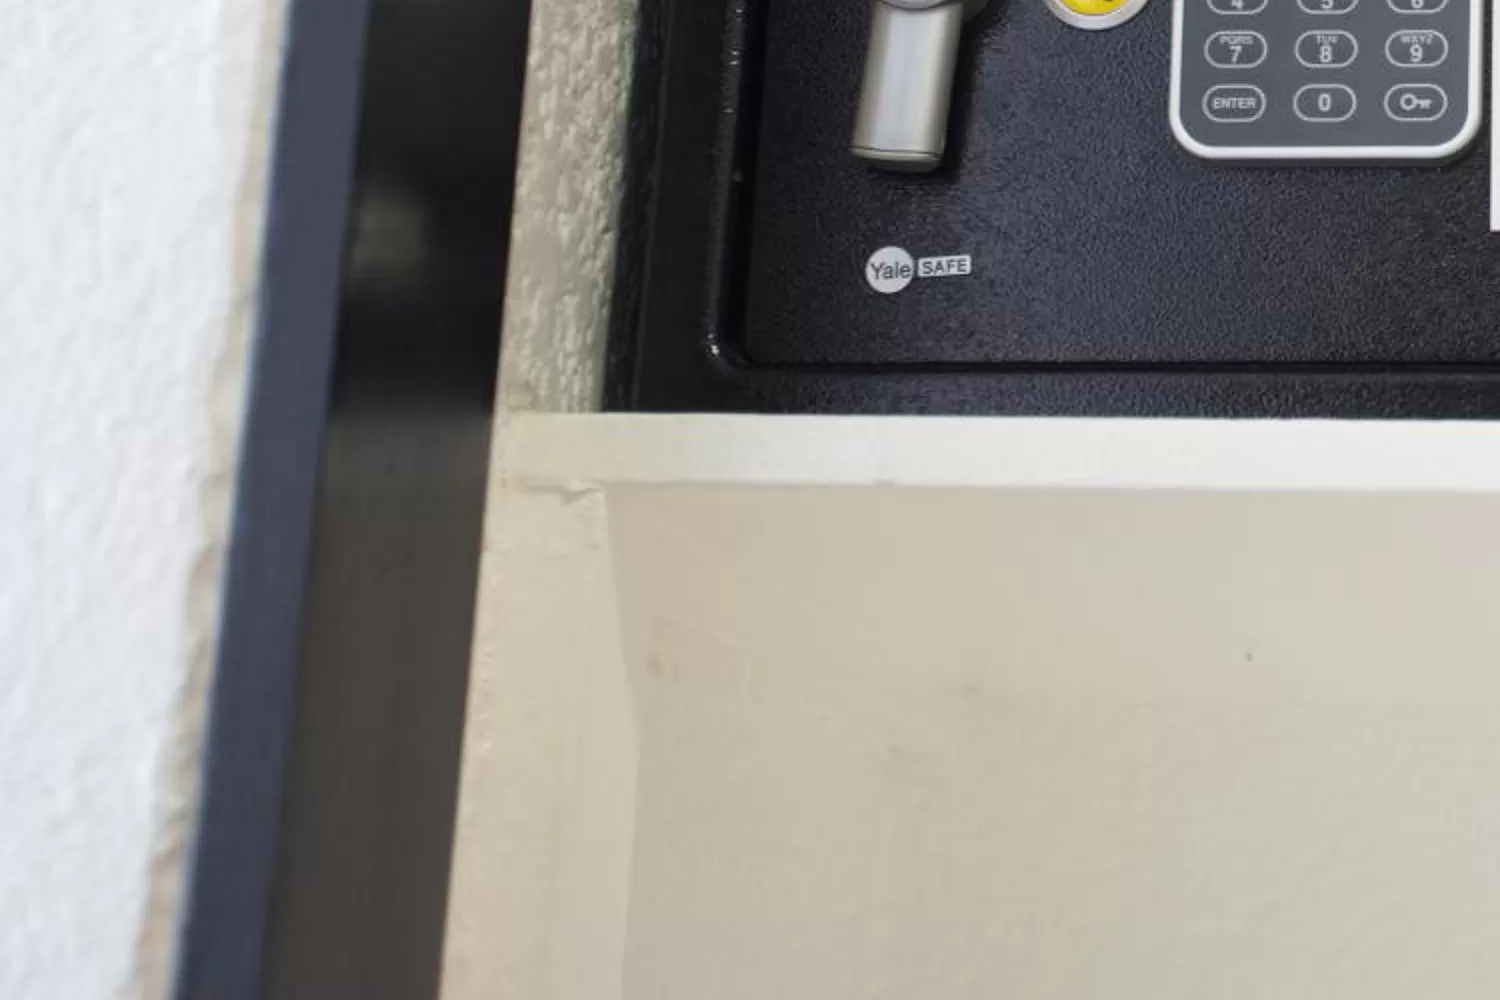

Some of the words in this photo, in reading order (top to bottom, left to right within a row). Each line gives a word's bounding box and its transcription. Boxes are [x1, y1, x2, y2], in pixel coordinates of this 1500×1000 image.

[1229, 45, 1242, 64] 7
[1320, 44, 1332, 63] 8
[1410, 44, 1423, 63] 9
[1213, 97, 1256, 109] ENTER
[1318, 93, 1331, 112] 0
[871, 261, 912, 280] Yale
[922, 259, 967, 275] SAFE
